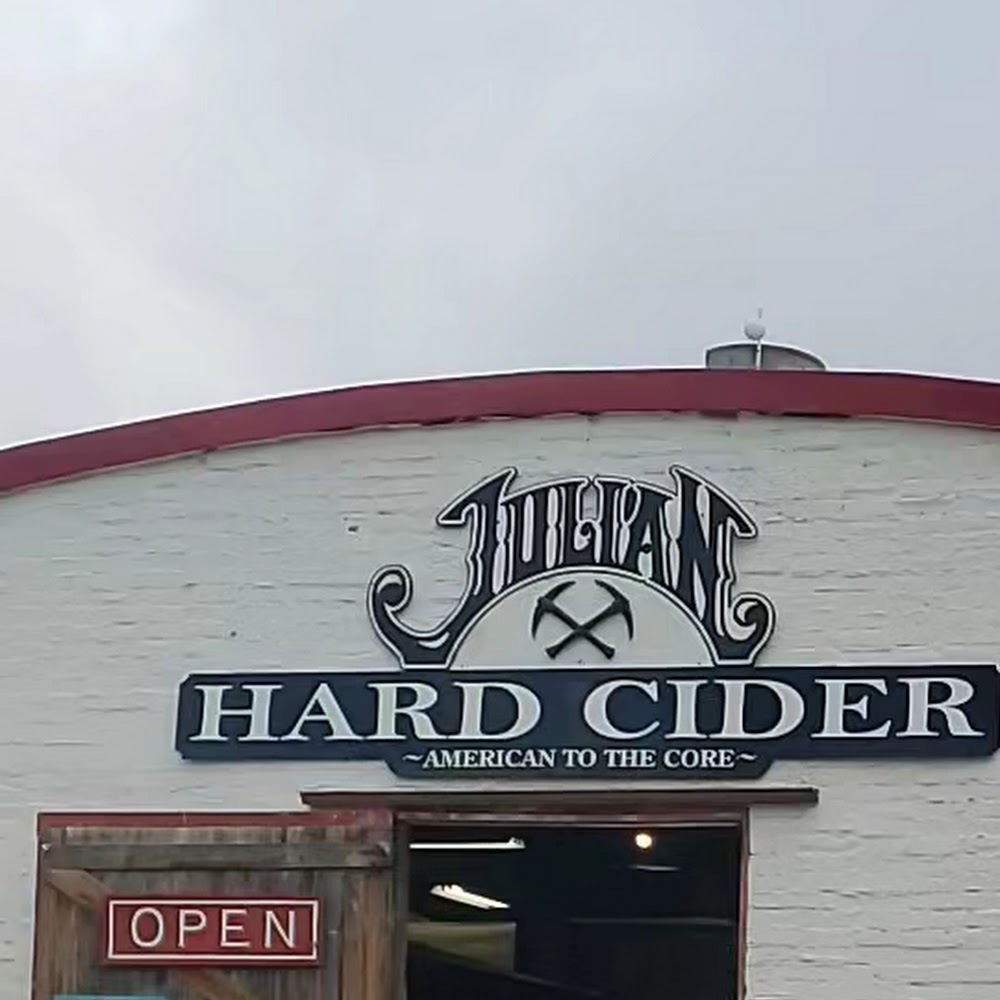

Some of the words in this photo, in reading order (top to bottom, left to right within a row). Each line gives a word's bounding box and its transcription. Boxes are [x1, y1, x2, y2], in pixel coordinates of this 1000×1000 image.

[367, 464, 776, 669] JULIAN
[188, 681, 542, 742] HARD
[583, 677, 985, 740] CIDER
[562, 749, 597, 768] TO
[604, 749, 656, 768] THE
[130, 906, 297, 949] OPEN
